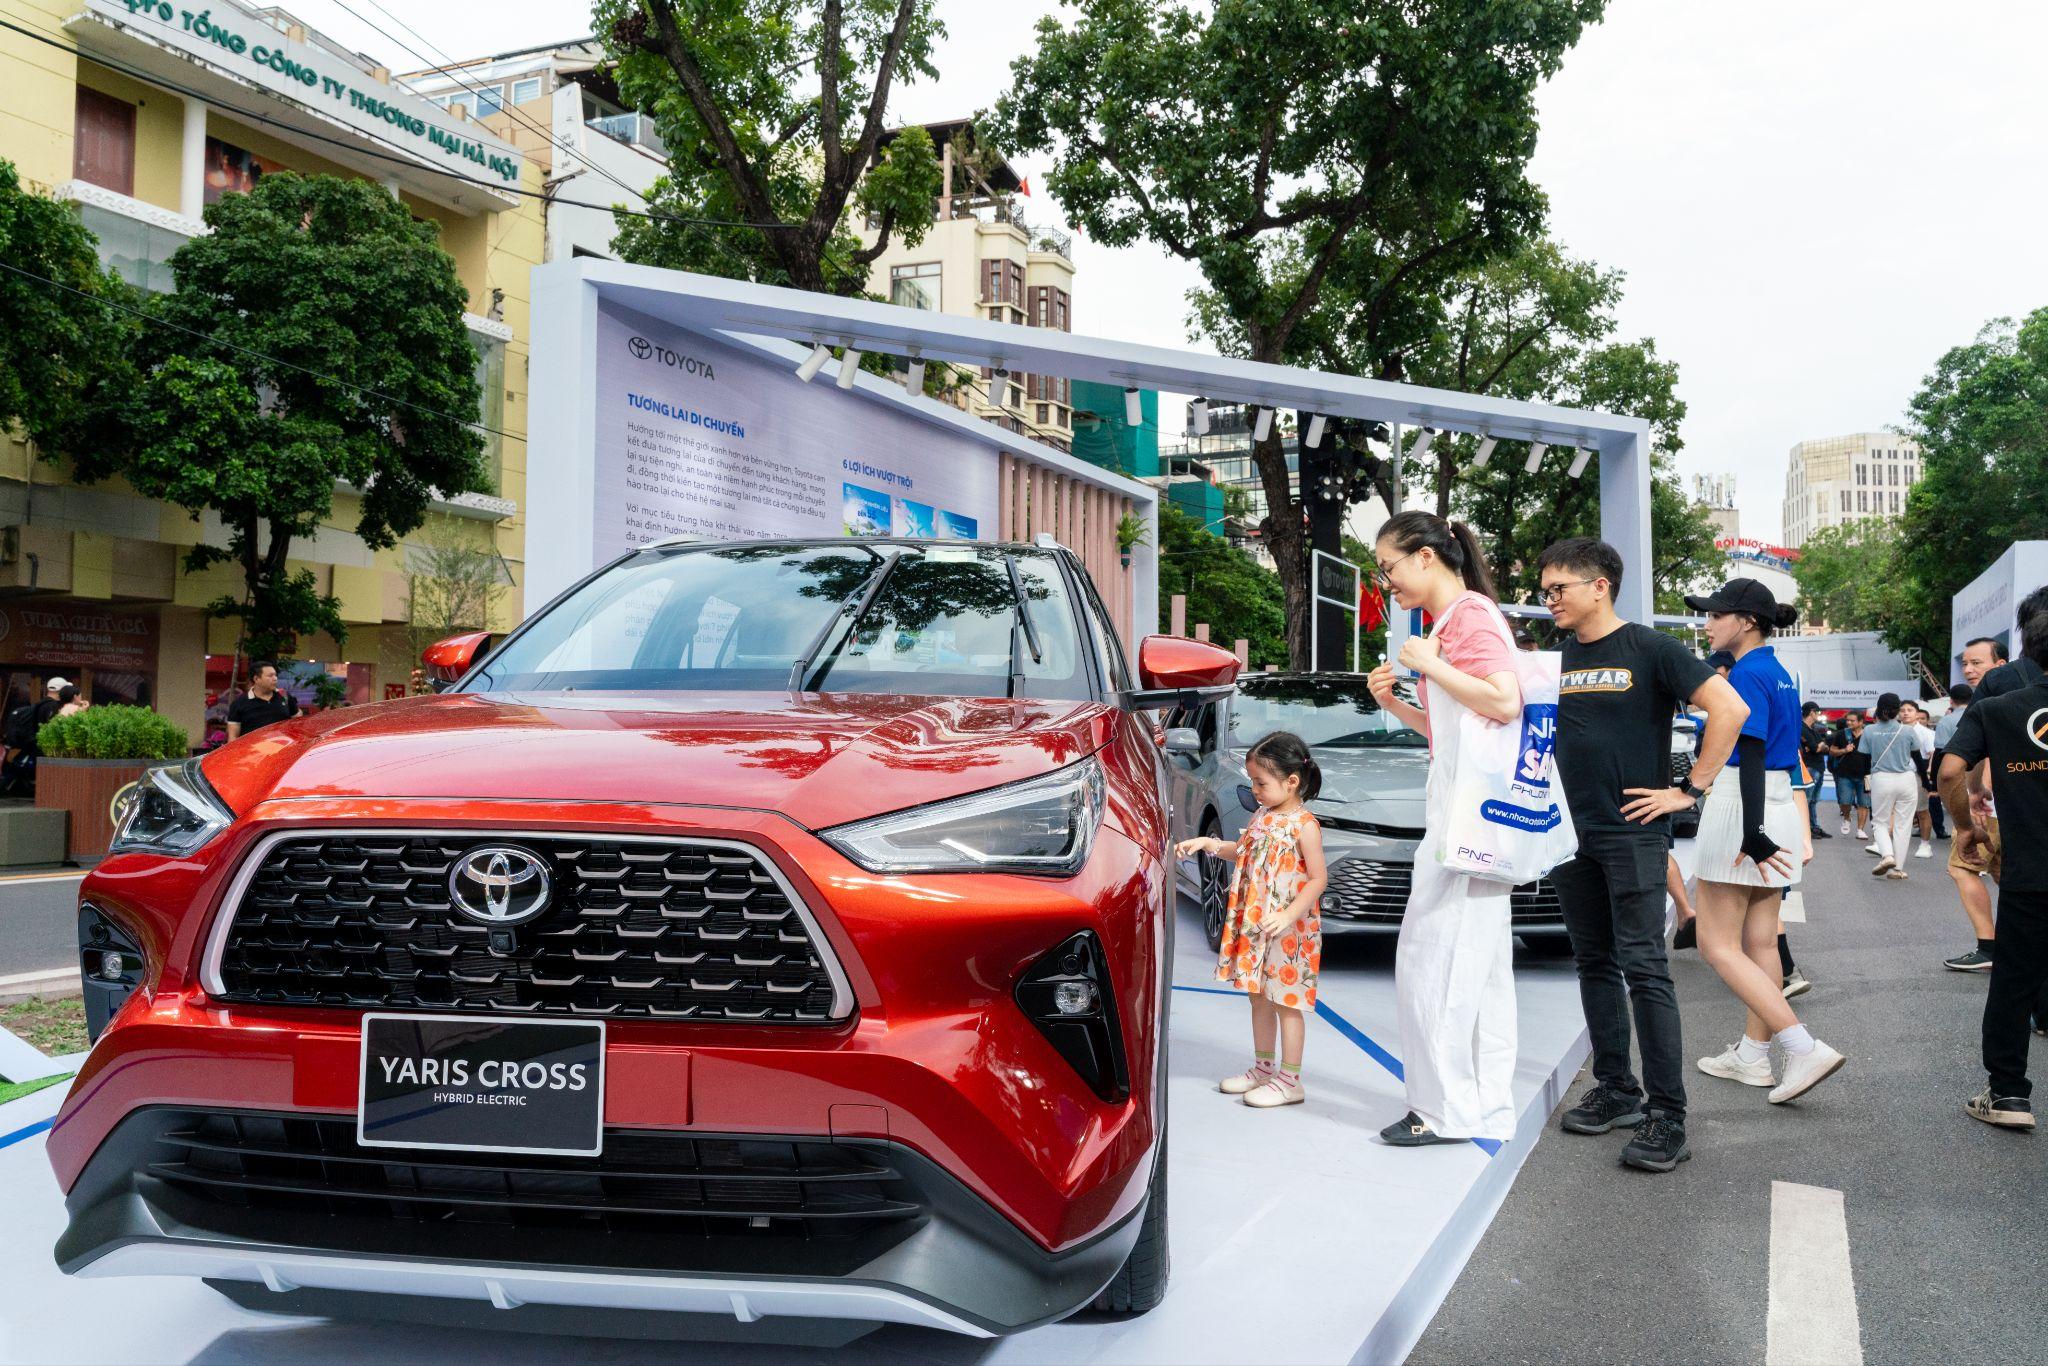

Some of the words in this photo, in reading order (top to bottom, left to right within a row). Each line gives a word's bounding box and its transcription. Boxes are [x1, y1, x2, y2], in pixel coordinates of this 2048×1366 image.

[181, 9, 247, 53] TỔNG
[252, 45, 318, 87] CÔNG
[322, 75, 346, 100] TY
[349, 88, 426, 137] THƯƠNG
[428, 125, 461, 155] MẠI
[462, 142, 487, 166] HÀ
[489, 153, 518, 181] NỘI
[655, 346, 715, 381] TOYOTA
[627, 393, 670, 417] TƯƠNG
[671, 406, 688, 422] LAI
[690, 412, 702, 426] DI
[682, 449, 692, 459] lai
[710, 446, 727, 456] xanh
[813, 474, 826, 483] cam
[686, 466, 695, 474] an
[842, 459, 848, 469] 6
[848, 461, 861, 475] LỢI
[862, 462, 876, 477] ÍCH
[876, 469, 897, 485] VƯỢT
[896, 475, 913, 491] TRỘI
[643, 483, 659, 493] trao
[670, 489, 685, 499] cho
[709, 498, 722, 507] mai
[742, 491, 751, 501] lai
[626, 517, 643, 528] khai
[677, 514, 697, 527] trung
[1560, 670, 1629, 687] TWEAR
[1527, 717, 1557, 739] NH
[1519, 744, 1554, 782] SÁ
[1458, 846, 1493, 864] PNC
[379, 1056, 469, 1087] YARIS
[478, 1060, 587, 1091] CROSS
[433, 1092, 474, 1104] HYBRID
[476, 1093, 527, 1106] ELECTRIC
